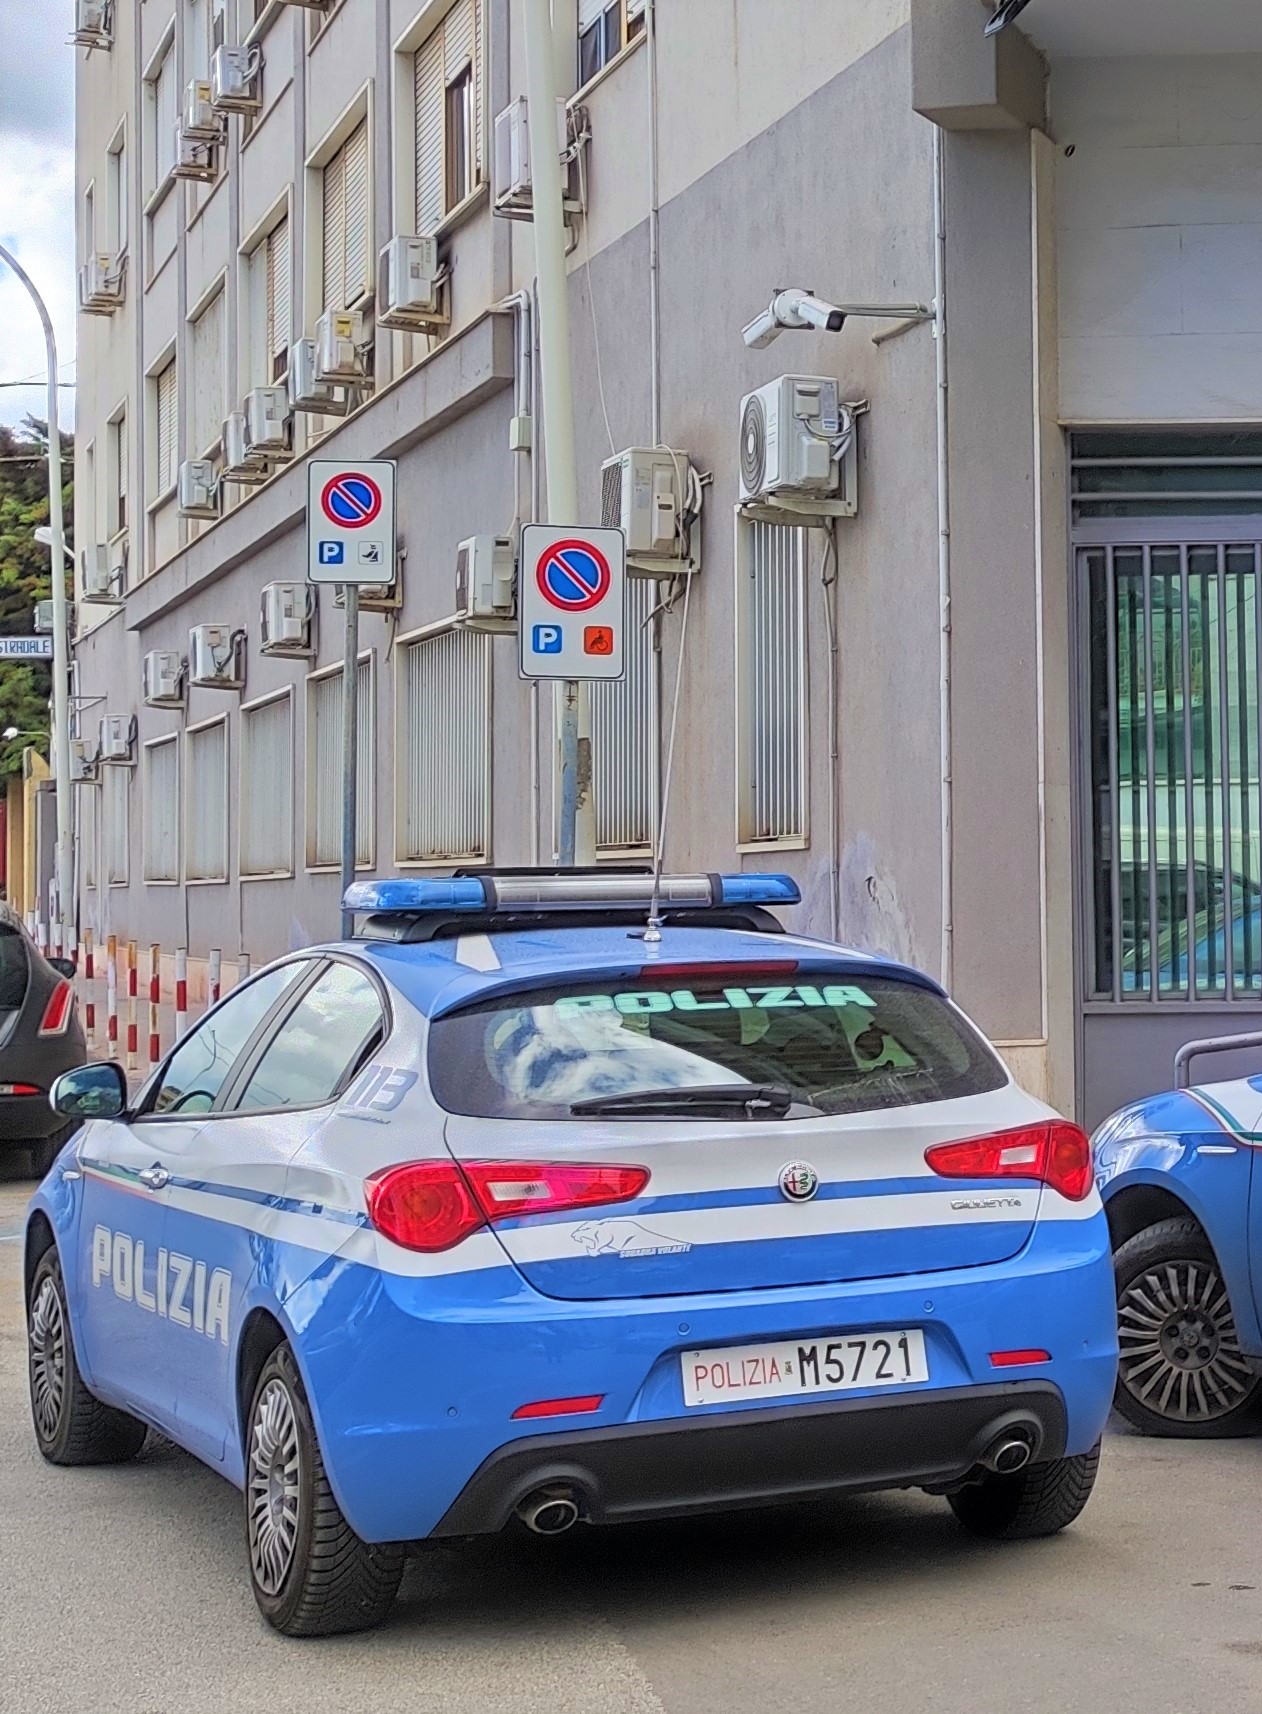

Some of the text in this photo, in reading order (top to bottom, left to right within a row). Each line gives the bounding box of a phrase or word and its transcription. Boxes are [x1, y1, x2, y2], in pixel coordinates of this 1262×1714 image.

[323, 543, 340, 563] P
[539, 628, 558, 651] P
[554, 985, 878, 1020] POLIZIA
[344, 1064, 419, 1112] 113
[92, 1224, 233, 1346] POLIZIA
[694, 1336, 912, 1391] POLIZIA M5721
